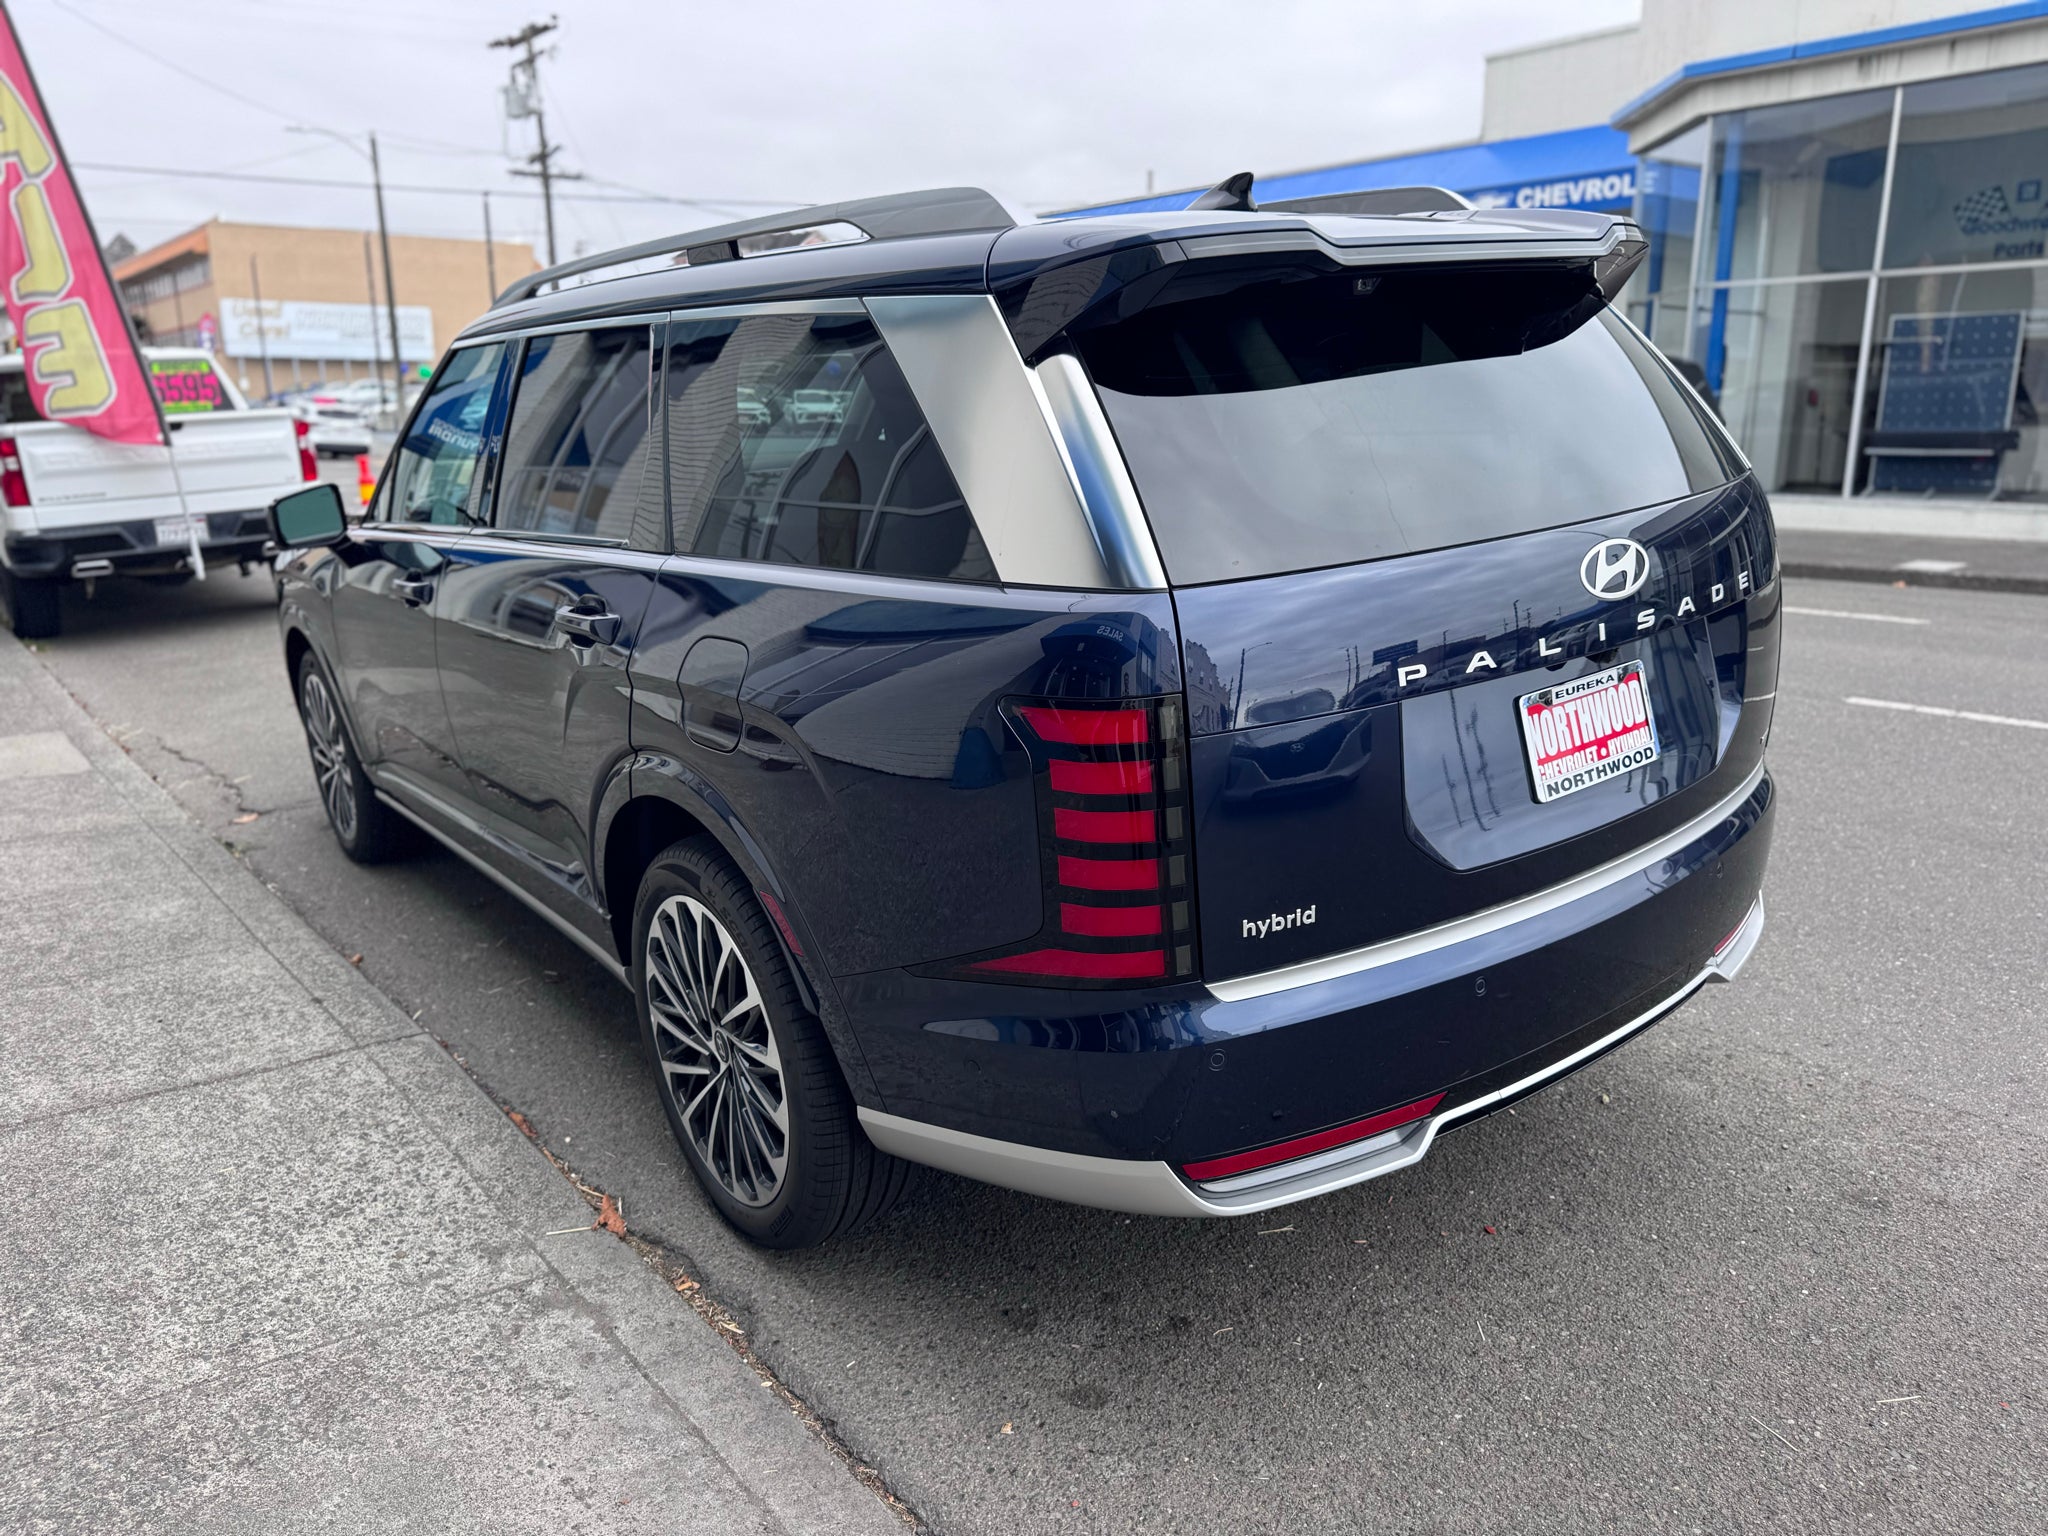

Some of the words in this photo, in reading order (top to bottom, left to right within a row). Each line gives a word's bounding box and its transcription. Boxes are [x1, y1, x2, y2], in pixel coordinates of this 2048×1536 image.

[1397, 571, 1750, 688] PALISADE
[1554, 674, 1615, 700] EUREKA
[1528, 680, 1647, 760] NORTHWOOD
[1539, 745, 1599, 780] CHEVROLET
[1607, 726, 1651, 758] HYUNDAI
[1546, 746, 1654, 797] NORTHWOOD
[1242, 904, 1316, 939] hybrid
